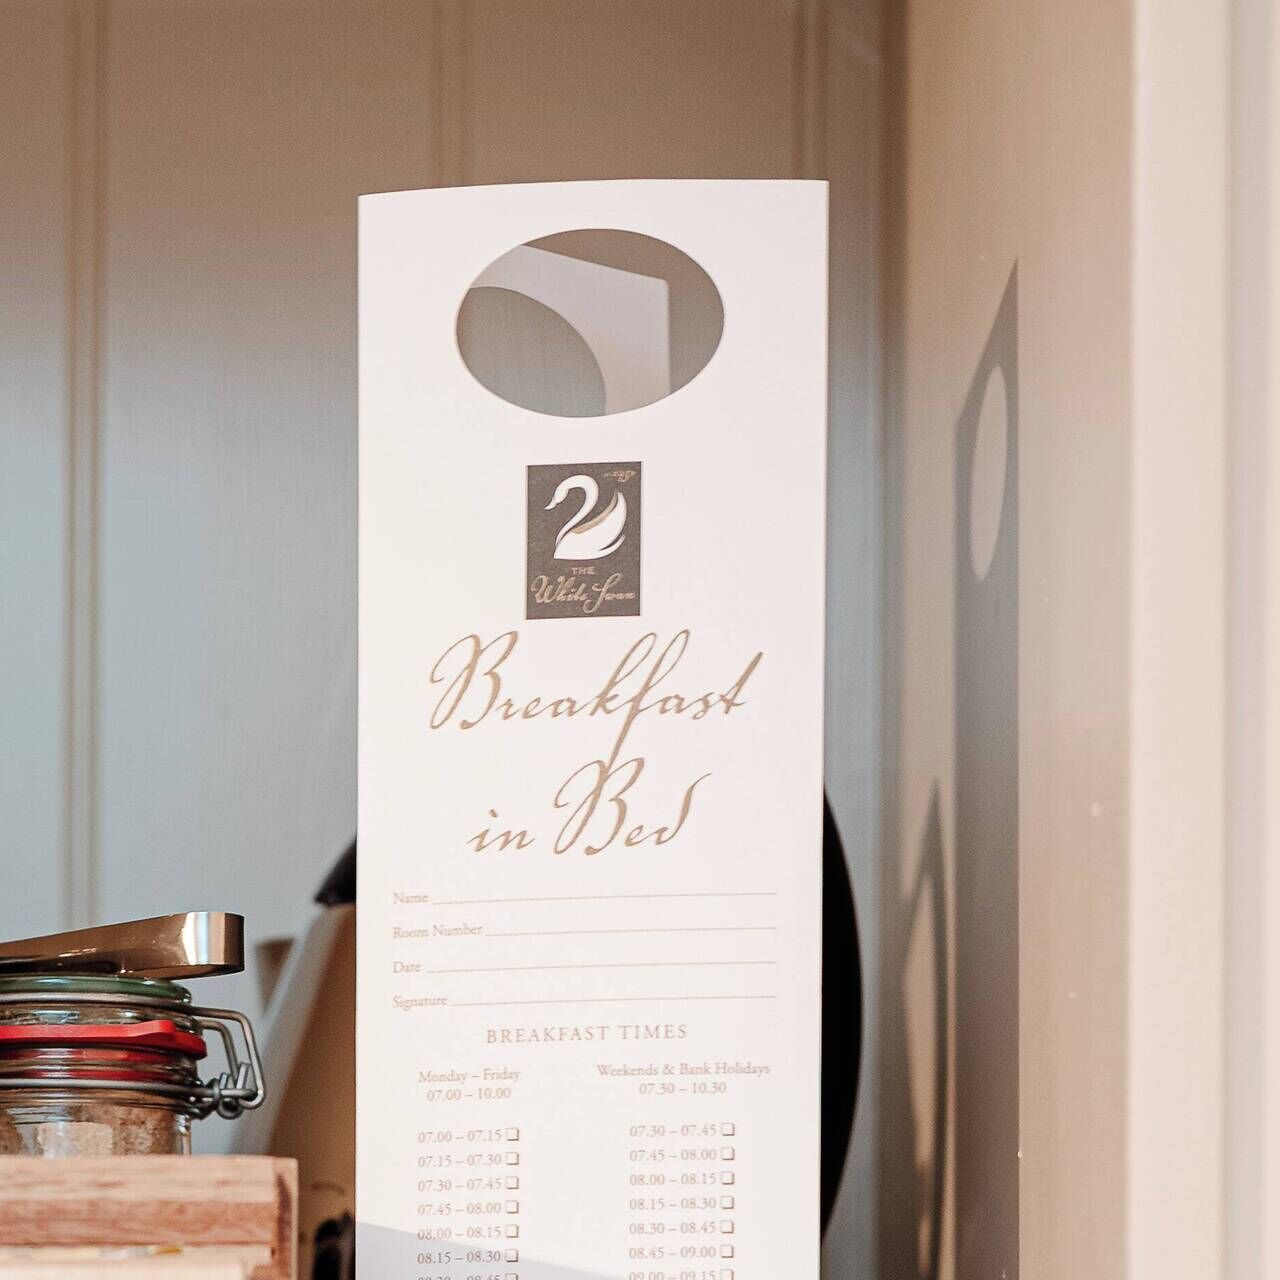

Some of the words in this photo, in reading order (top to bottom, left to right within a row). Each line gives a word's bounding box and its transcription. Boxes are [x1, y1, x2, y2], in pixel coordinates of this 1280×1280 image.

[572, 566, 595, 574] THE
[531, 574, 588, 603] White
[583, 573, 635, 613] Swan
[429, 630, 763, 766] Breakfast
[466, 808, 536, 852] in
[553, 757, 712, 856] Bed
[393, 892, 428, 904] Name
[393, 927, 428, 939] Room
[432, 923, 483, 937] Number
[393, 961, 421, 973] Date
[393, 995, 448, 1011] Signature
[486, 1025, 610, 1044] BREAKFAST
[619, 1023, 688, 1041] TIMES
[418, 1070, 469, 1084] Monday
[482, 1067, 521, 1083] Friday
[596, 1063, 659, 1077] Weekends
[662, 1064, 675, 1076] &
[679, 1062, 711, 1075] Bank
[715, 1061, 771, 1077] Holidays
[426, 1088, 462, 1102] 07.00
[477, 1087, 512, 1100] 10.00
[638, 1082, 675, 1095] 07.30
[692, 1081, 727, 1095] 10.30
[417, 1131, 452, 1144] 07.00
[467, 1129, 503, 1142] 07.15
[629, 1124, 666, 1137] 07.30
[680, 1124, 717, 1136] 07.45
[418, 1155, 452, 1168] 07.15
[467, 1152, 502, 1166] 07.30
[629, 1149, 665, 1162] 07.45
[680, 1149, 718, 1160] 08.00
[418, 1180, 452, 1192] 07.30
[467, 1178, 502, 1190] 07.45
[629, 1174, 666, 1186] 08.00
[681, 1173, 716, 1185] 08.15
[417, 1203, 451, 1216] 07.45
[466, 1200, 501, 1215] 08.00
[629, 1198, 665, 1210] 08.15
[680, 1197, 717, 1209] 08.30
[417, 1228, 452, 1242] 08.00
[466, 1224, 501, 1239] 08.15
[629, 1222, 666, 1235] 08.30
[680, 1221, 716, 1234] 08.45
[417, 1251, 451, 1264] 08.15
[465, 1249, 501, 1263] 08.30
[628, 1247, 664, 1259] 08.45
[680, 1246, 717, 1258] 09.00
